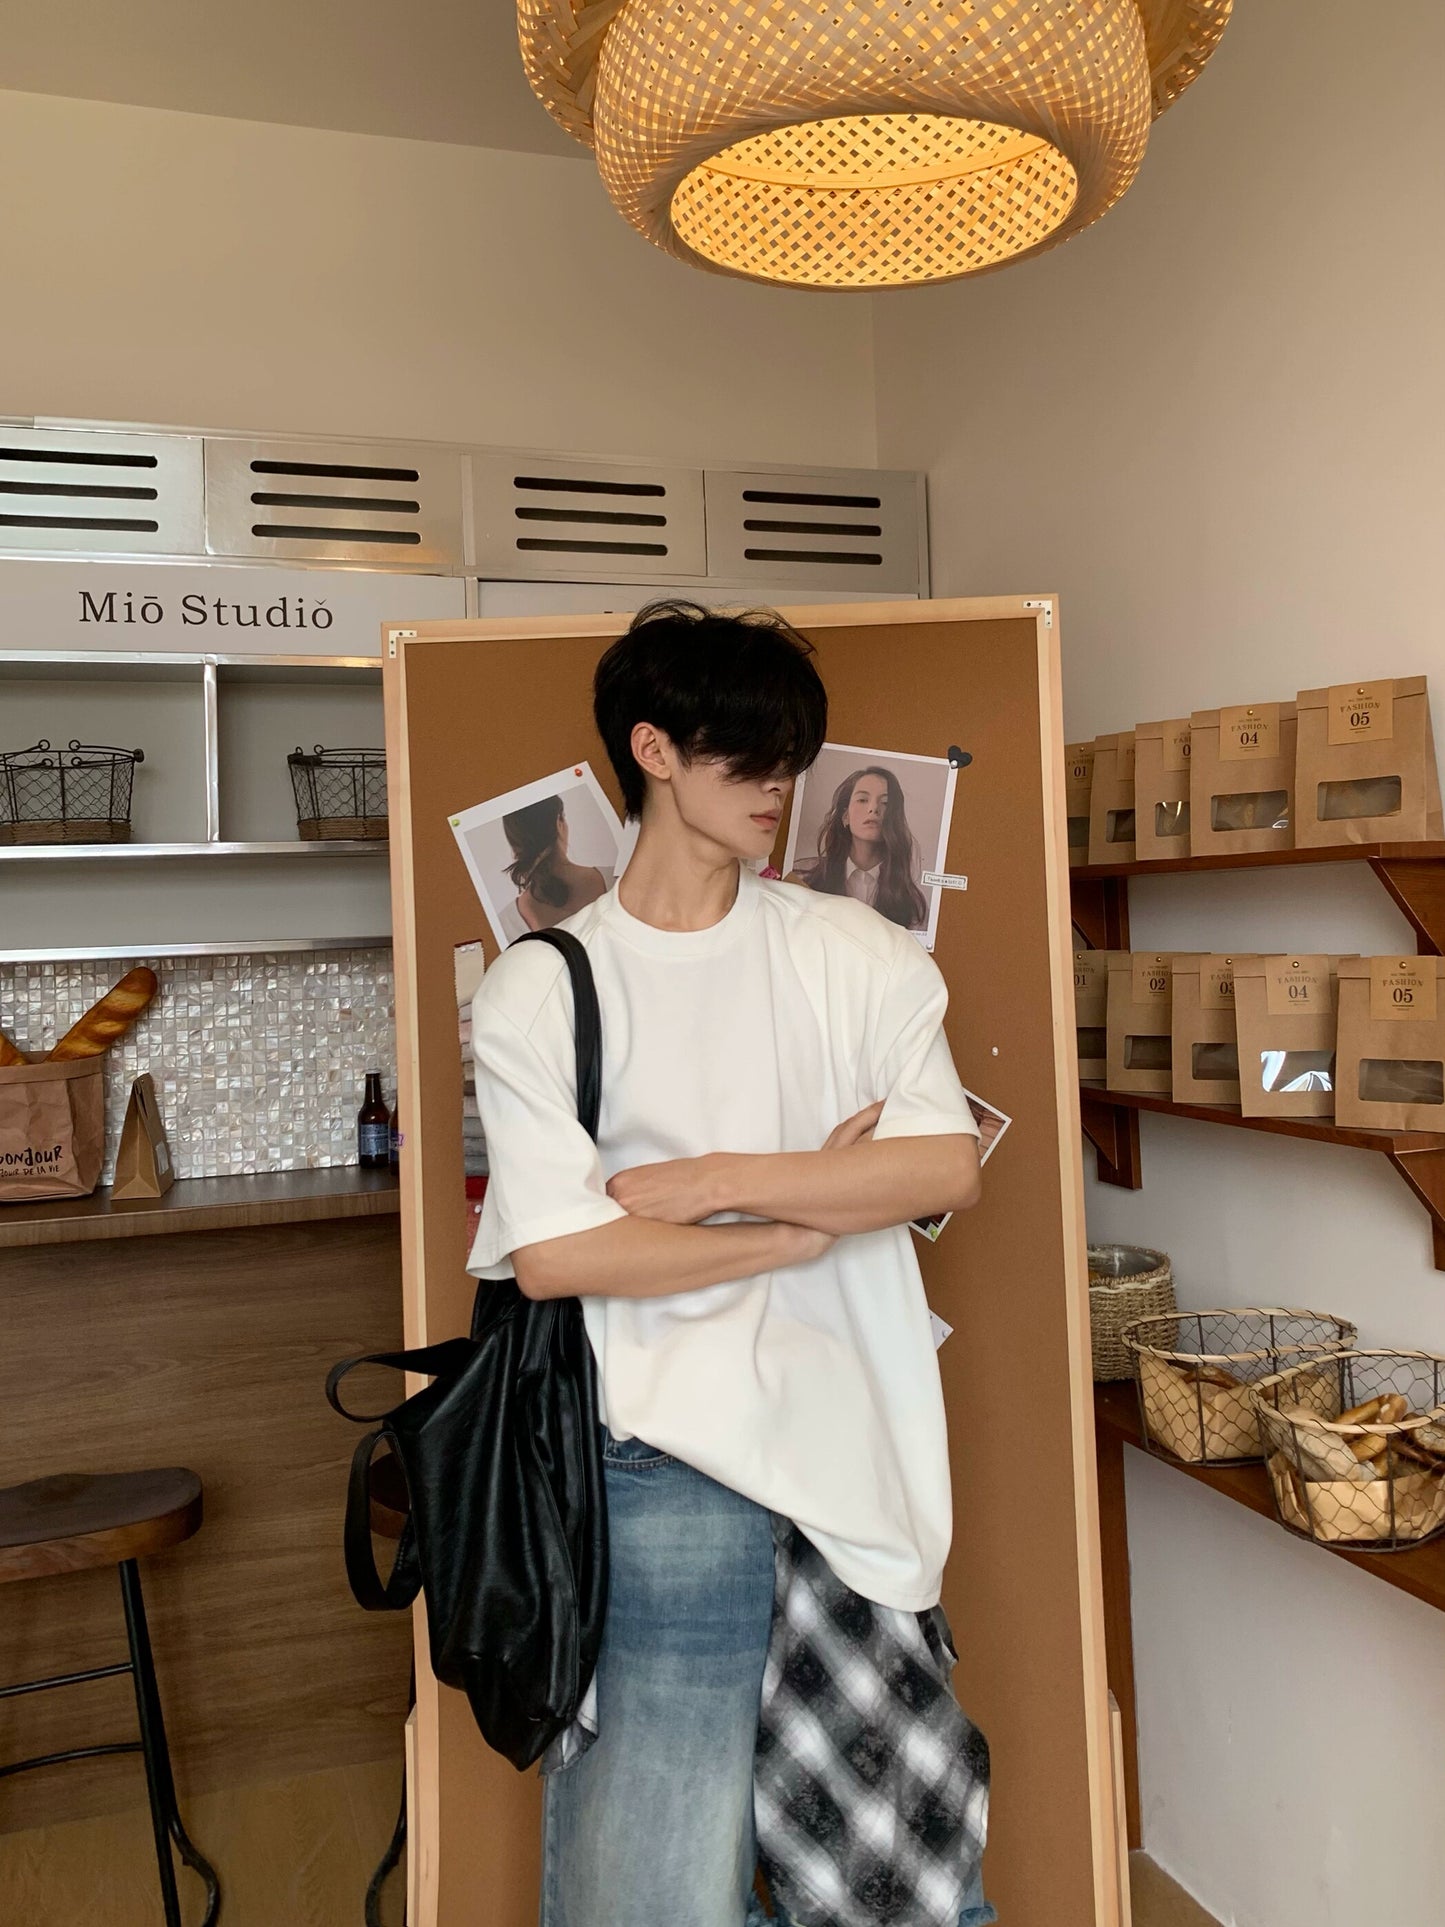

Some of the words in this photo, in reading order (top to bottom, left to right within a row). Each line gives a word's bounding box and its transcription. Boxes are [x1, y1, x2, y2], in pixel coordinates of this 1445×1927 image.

[78, 591, 164, 624] Miō
[1340, 702, 1380, 712] FASHION
[1350, 711, 1370, 727] 05
[1231, 723, 1268, 732] FASHION
[1240, 731, 1258, 745] 04
[1073, 766, 1087, 777] 01
[1149, 977, 1166, 991] 02
[1278, 976, 1317, 985] FASHION
[1382, 979, 1424, 987] FASHION
[1288, 984, 1308, 999] 04
[1393, 988, 1413, 1003] 05
[22, 1168, 35, 1176] DE
[36, 1165, 47, 1175] LA
[48, 1164, 60, 1173] VIE
